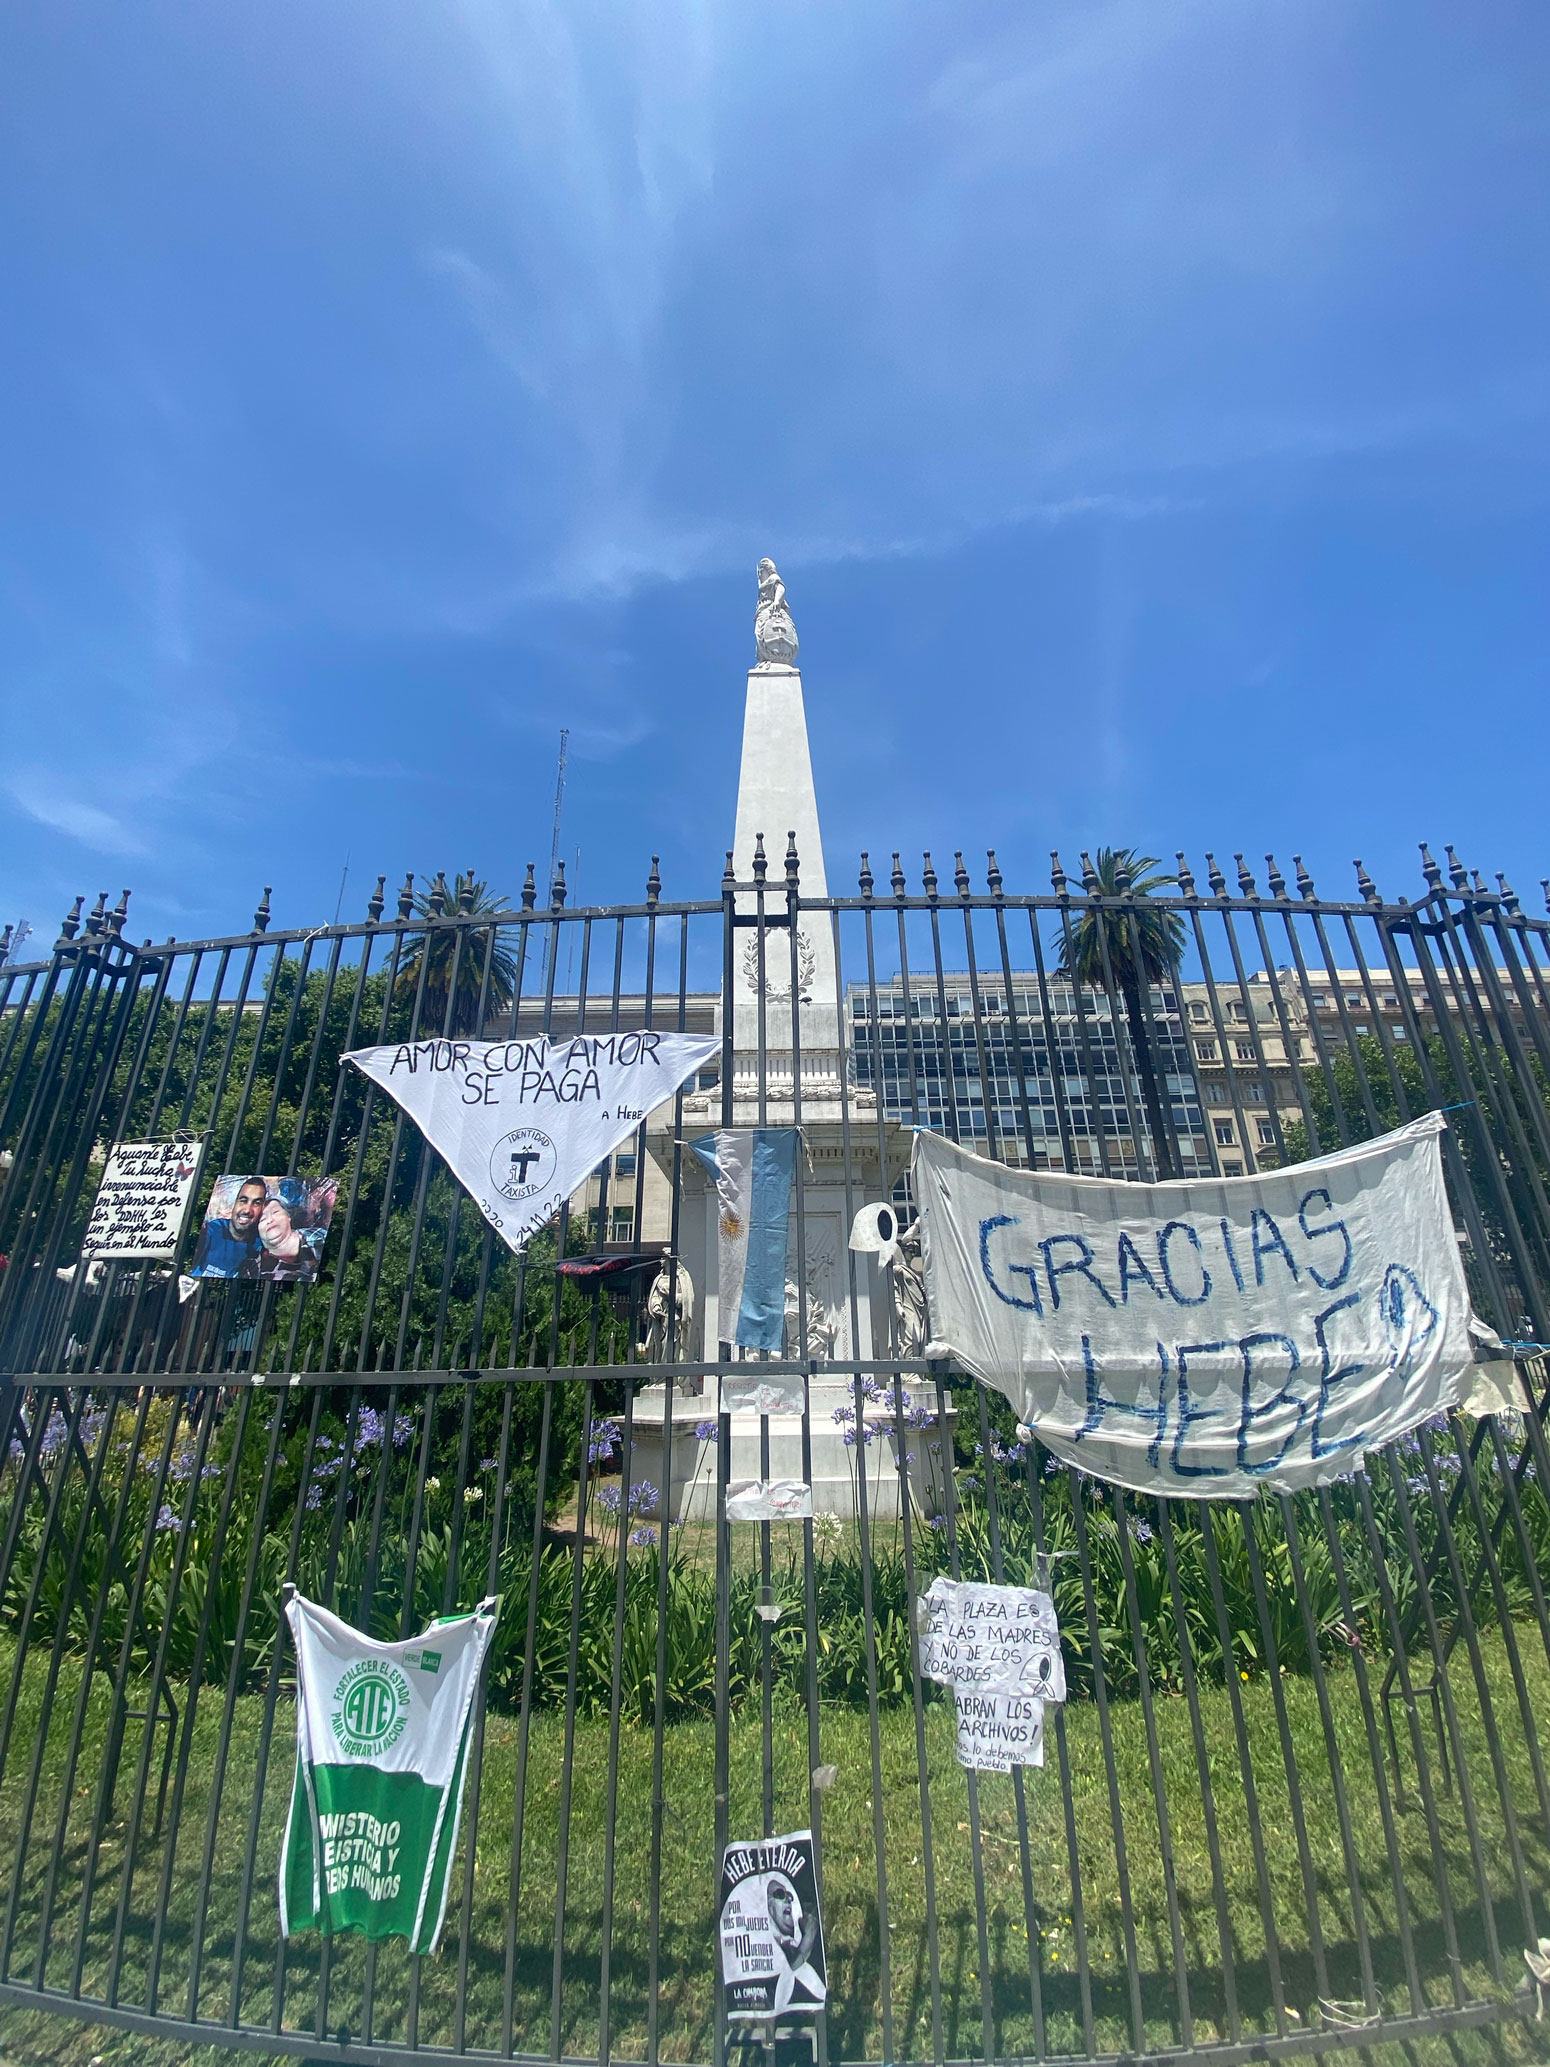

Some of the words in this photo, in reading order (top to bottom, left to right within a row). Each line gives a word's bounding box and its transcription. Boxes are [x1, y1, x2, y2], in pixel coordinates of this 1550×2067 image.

[389, 1040, 471, 1075] AMOR
[484, 1039, 544, 1072] CON
[566, 1033, 661, 1070] AMOR
[462, 1072, 503, 1105] SE
[520, 1069, 601, 1104] PAGA
[508, 1130, 550, 1147] IDENTIDAD
[500, 1182, 540, 1198] TAXISTA
[120, 1209, 146, 1222] DDHH
[979, 1188, 1354, 1318] GRACIAS
[1075, 1288, 1367, 1477] HEBE
[929, 1595, 948, 1617] LA
[963, 1601, 1007, 1620] PLAZA
[1016, 1603, 1040, 1618] ES
[926, 1619, 943, 1634] DE
[949, 1624, 976, 1640] LAS
[988, 1625, 1052, 1646] MADRES
[924, 1641, 934, 1660] Y
[941, 1643, 957, 1660] NO
[962, 1644, 981, 1660] DE
[990, 1648, 1022, 1664] LOS
[333, 1660, 378, 1701] FORTALECER
[380, 1661, 390, 1675] EL
[389, 1668, 411, 1706] ESTADO
[347, 1680, 391, 1734] ATE
[956, 1696, 997, 1717] ABRAN
[1006, 1701, 1032, 1719] LOS
[331, 1711, 345, 1740] PARA
[339, 1735, 372, 1757] LIBERAR
[374, 1741, 383, 1756] LA
[388, 1847, 400, 1872] Y
[723, 1848, 756, 1883] HEBE
[728, 1900, 741, 1915] POR
[746, 1917, 769, 1931] JUEVES
[735, 1933, 751, 1958] NO
[751, 1943, 774, 1957] VENDER
[741, 1959, 750, 1973] LA
[751, 1958, 774, 1972] SANGRE
